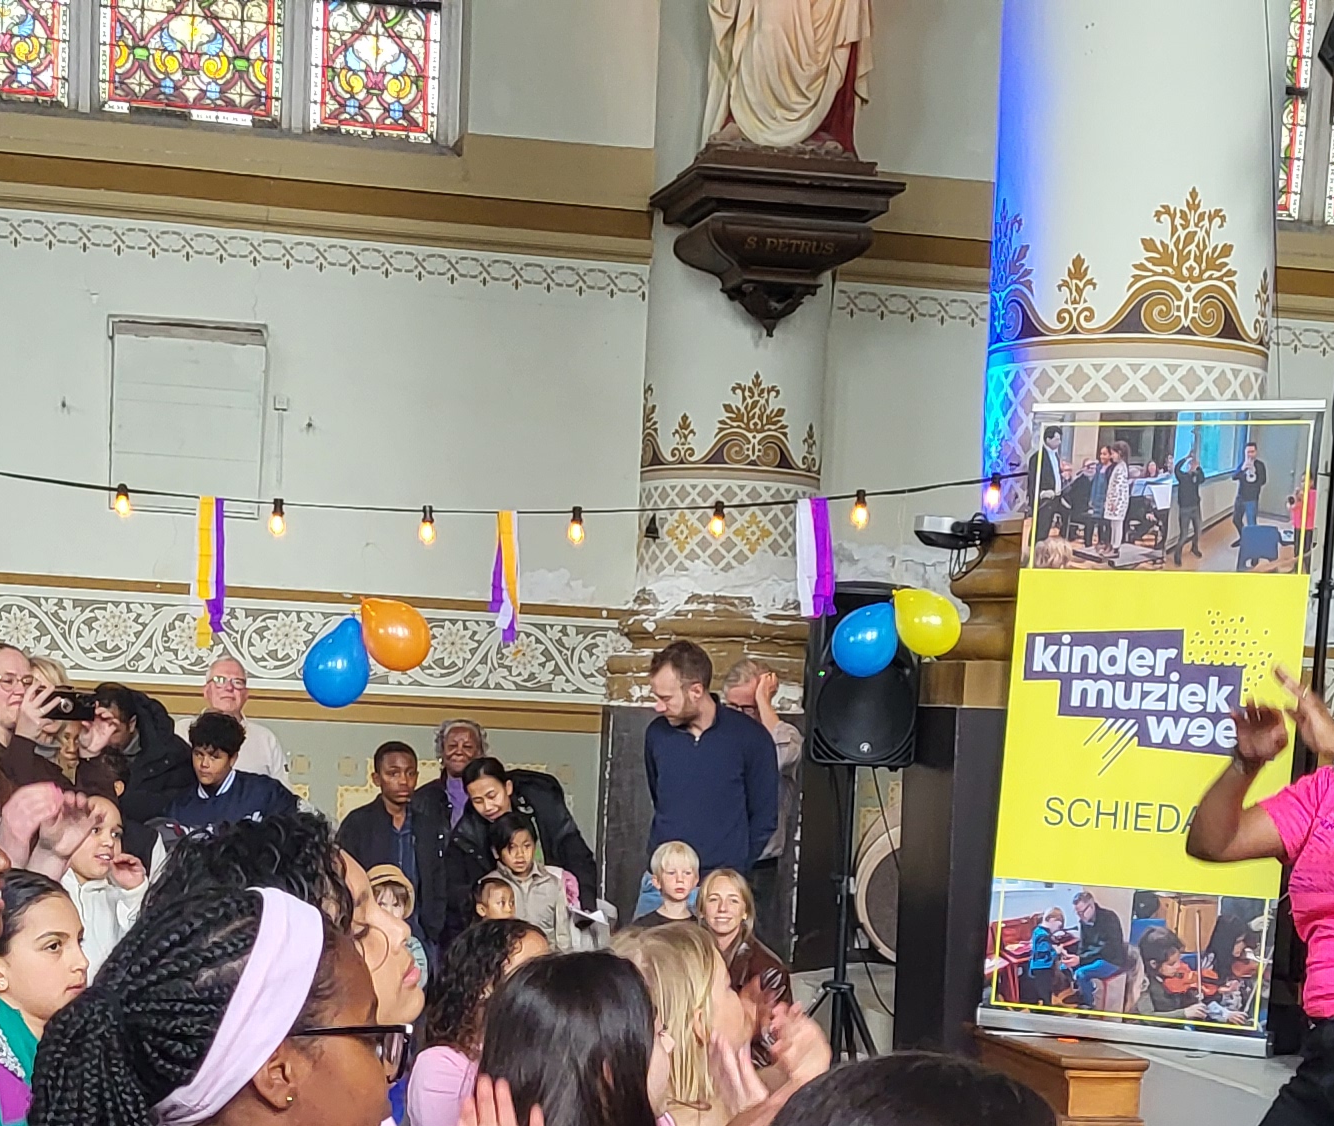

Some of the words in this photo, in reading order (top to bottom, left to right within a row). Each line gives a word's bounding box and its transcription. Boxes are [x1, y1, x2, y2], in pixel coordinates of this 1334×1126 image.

[1032, 634, 1178, 677] kinder
[1069, 671, 1234, 713] muziek
[1146, 715, 1238, 748] wee
[1044, 796, 1198, 835] SCHIEDA
